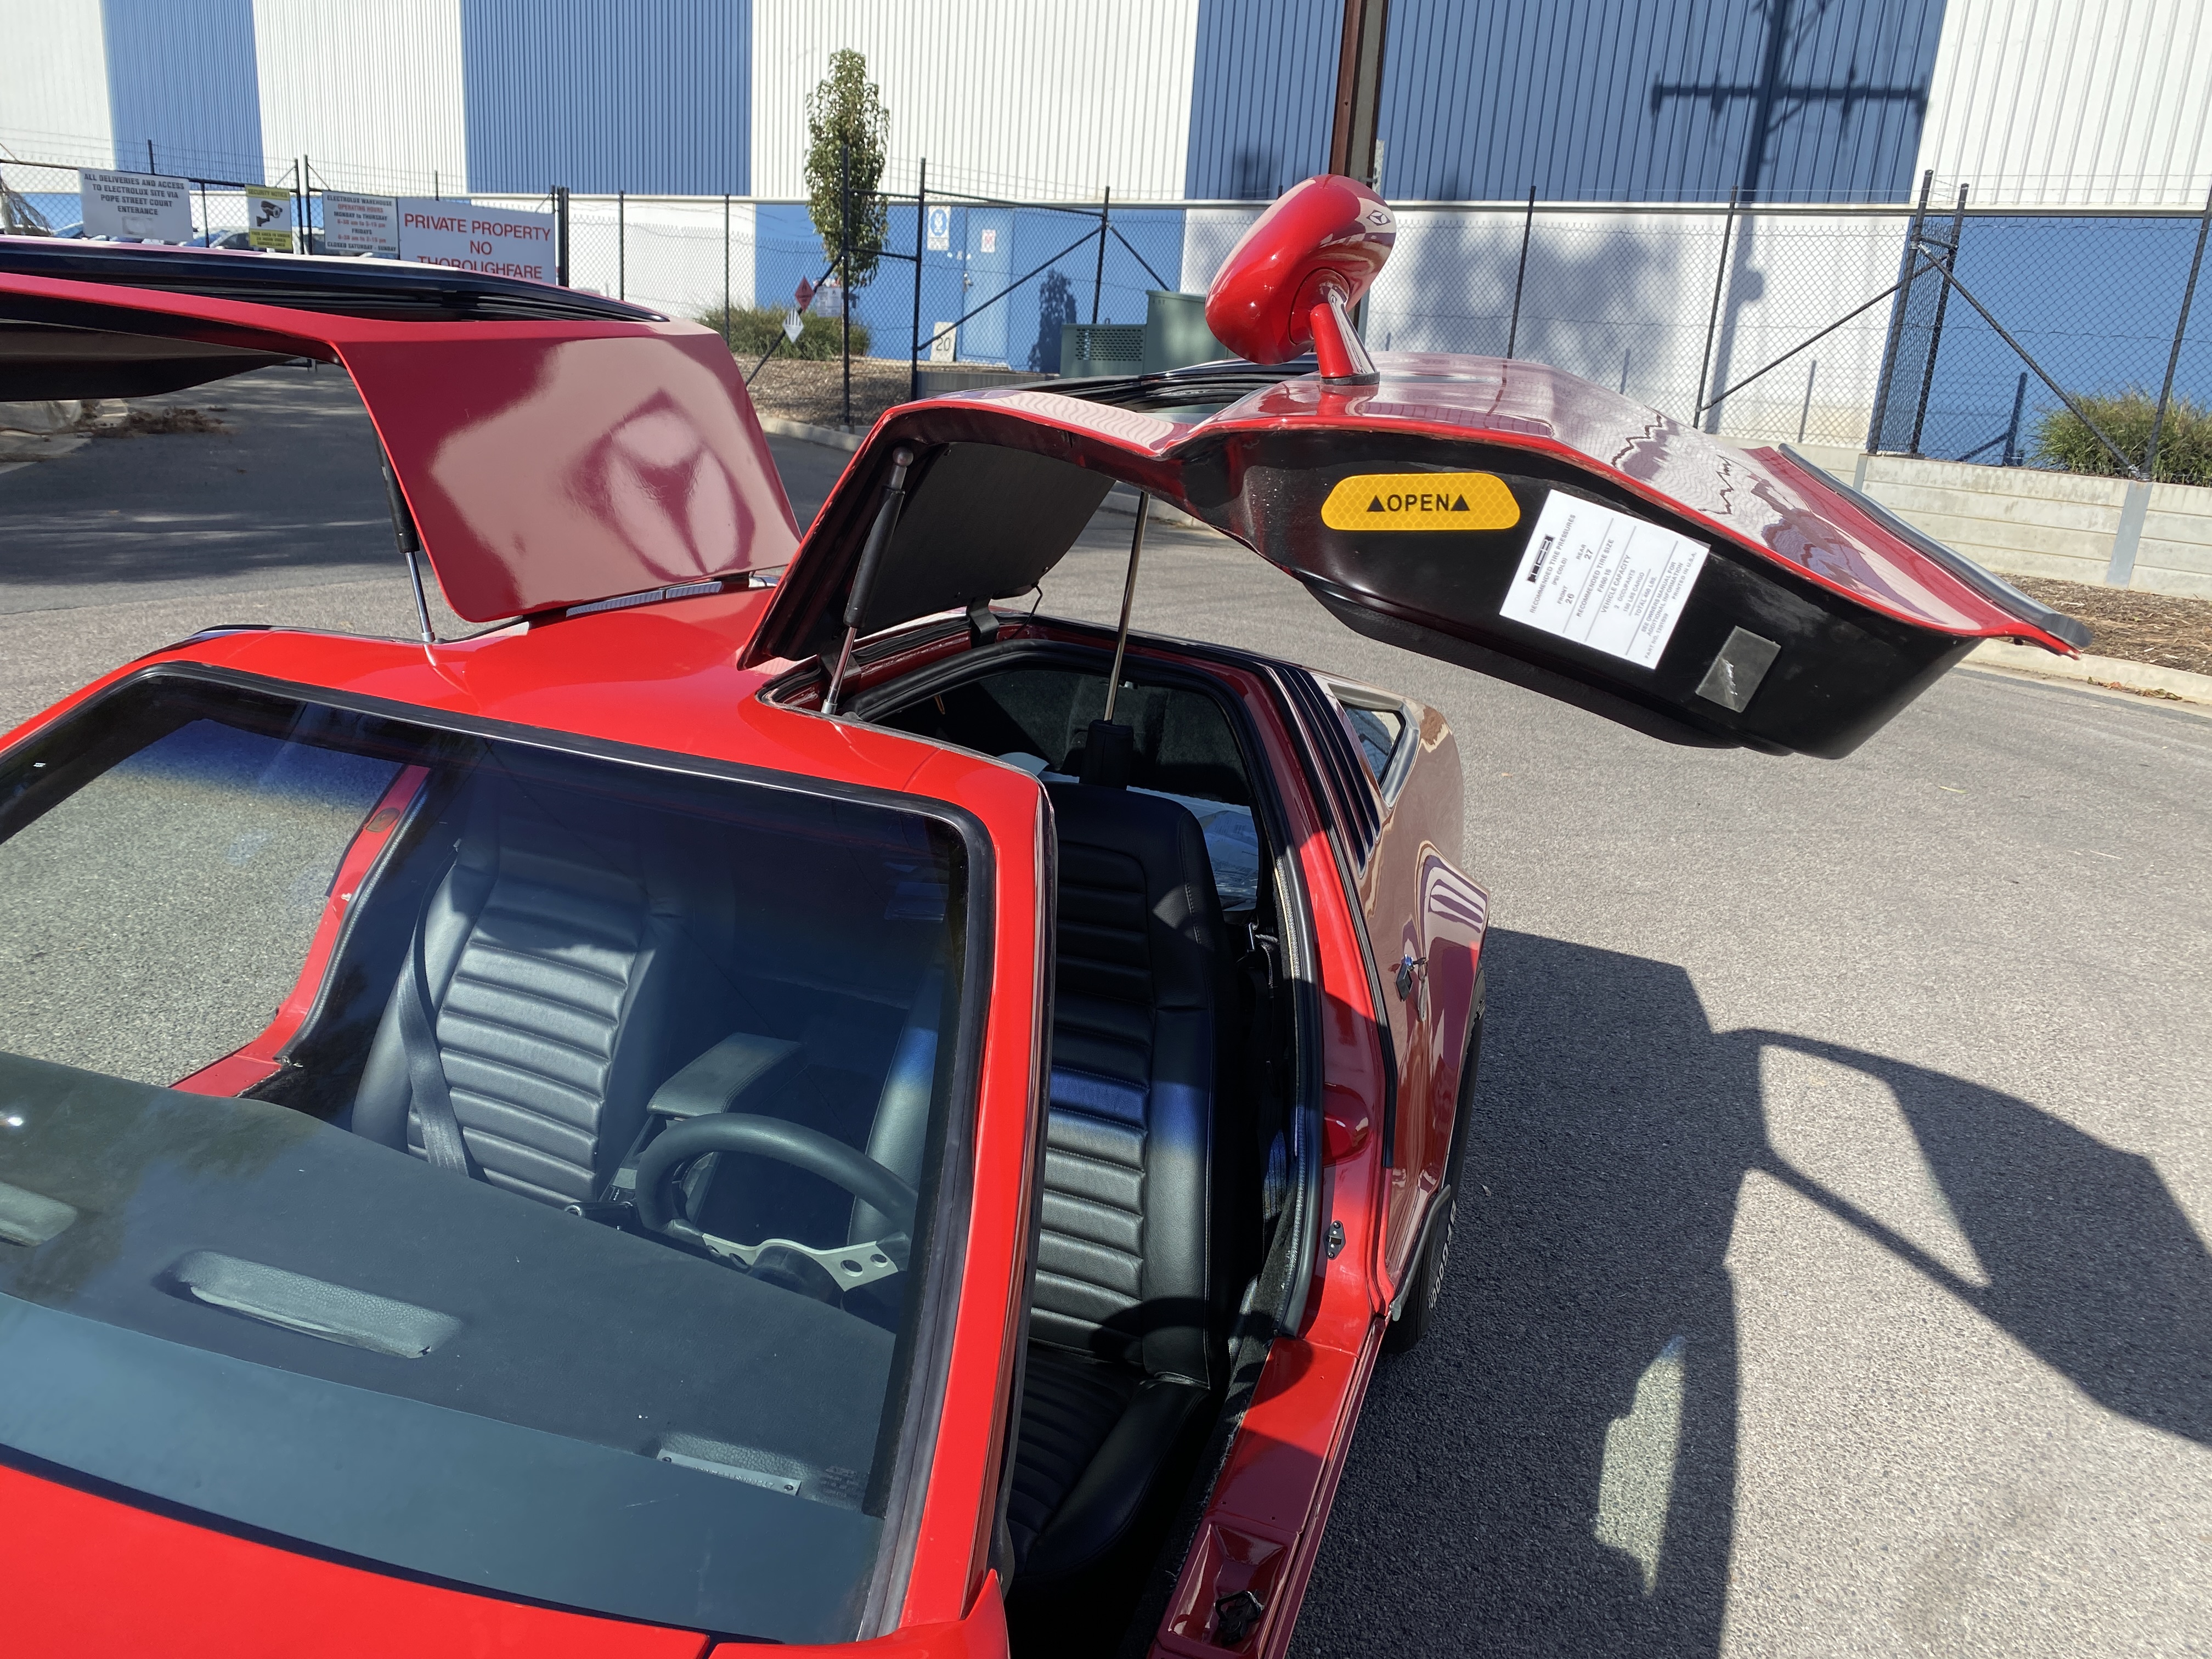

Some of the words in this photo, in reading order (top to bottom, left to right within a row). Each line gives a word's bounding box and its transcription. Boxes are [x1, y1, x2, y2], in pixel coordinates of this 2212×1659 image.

[99, 175, 139, 185] DELIVERIES
[101, 194, 120, 202] POPE
[122, 196, 147, 205] STREET
[104, 185, 148, 195] ELECTROLUX
[327, 195, 360, 204] ELECTROLUX
[361, 198, 392, 206] WAREHOUSE
[337, 204, 365, 212] OPERATING
[117, 206, 158, 215] ENTERANCE
[404, 213, 467, 234] PRIVATE
[472, 220, 551, 241] PROPERTY
[470, 240, 492, 255] NO
[417, 256, 543, 279] THOROUGHFARE
[936, 337, 951, 351] 20
[1387, 494, 1449, 512] OPEN
[1529, 566, 1553, 614] RECOMMENDED
[1549, 550, 1560, 565] TIRE
[1555, 514, 1576, 550] PRESSURES
[1667, 561, 1677, 574] FOR
[1556, 585, 1568, 605] FRONT
[1575, 544, 1587, 560] REAR
[1565, 593, 1575, 605] 26
[1584, 548, 1594, 560] 27
[1576, 569, 1601, 618] RECOMMENDED
[1596, 554, 1608, 569] TIRE
[1603, 539, 1615, 554] SIZE
[1600, 586, 1617, 613] VEHICLE
[1613, 554, 1632, 586] CAPACITY
[1632, 572, 1645, 592] CARGO
[1617, 569, 1636, 602] OCCUPANTS
[1656, 575, 1672, 599] MANUAL
[1671, 575, 1686, 600] PRINTED
[1634, 599, 1647, 616] TOTAL
[1646, 603, 1666, 637] ADDITIONAL
[1661, 562, 1684, 602] INFORMATION
[1645, 598, 1661, 622] OWNERS
[1641, 622, 1650, 633] SEE
[1644, 644, 1654, 659] PART
